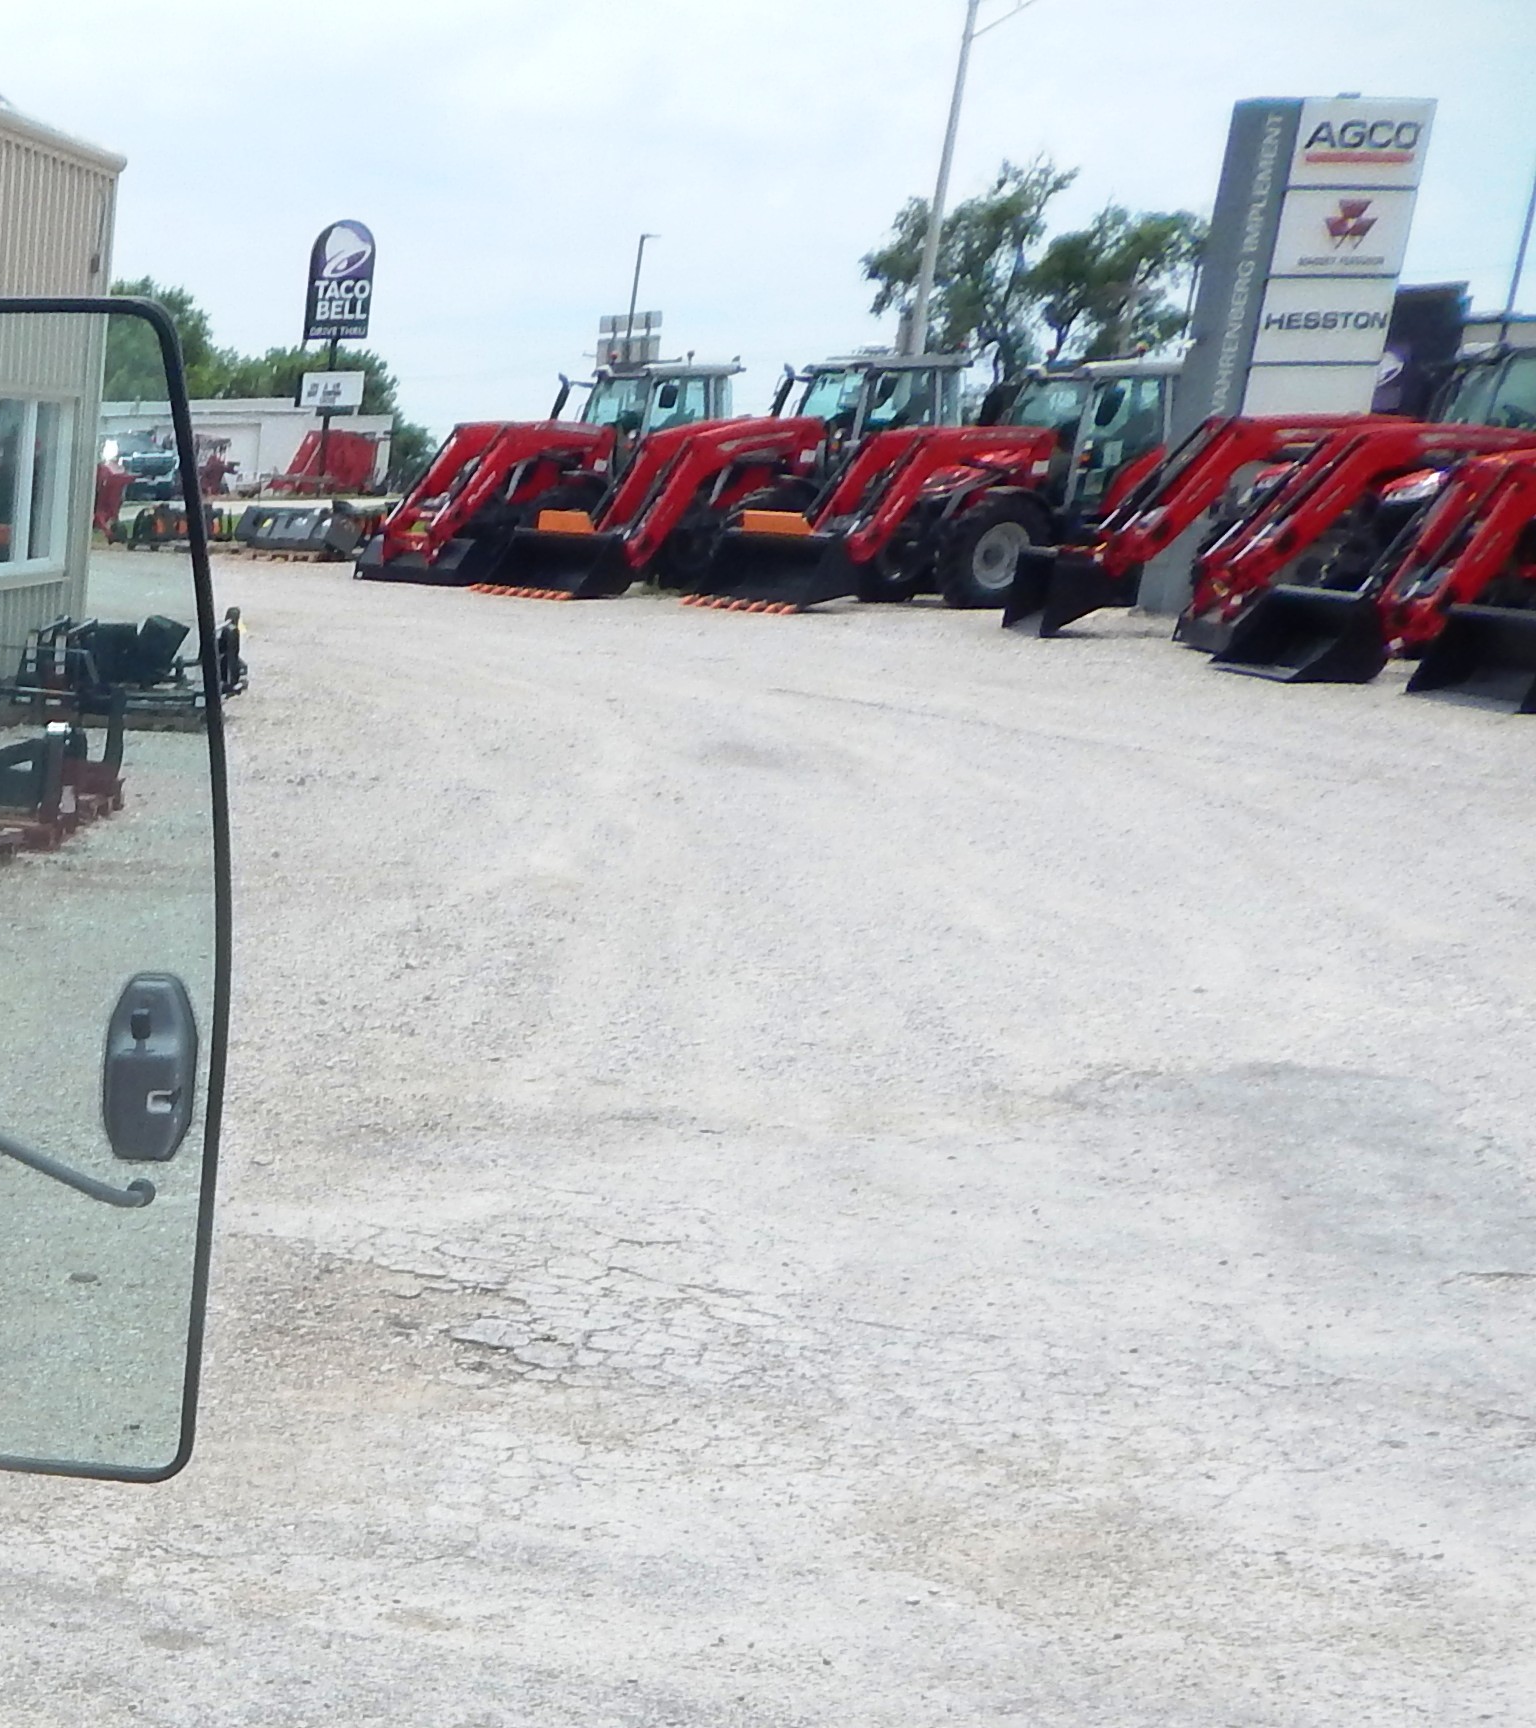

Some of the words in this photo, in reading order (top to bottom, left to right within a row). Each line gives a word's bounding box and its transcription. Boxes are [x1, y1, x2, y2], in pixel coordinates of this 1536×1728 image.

[1305, 120, 1421, 149] AGCO
[1243, 112, 1284, 251] IMPLEMENT
[314, 279, 371, 300] TACO
[315, 300, 367, 321] BELL
[1265, 311, 1387, 331] HESSTON
